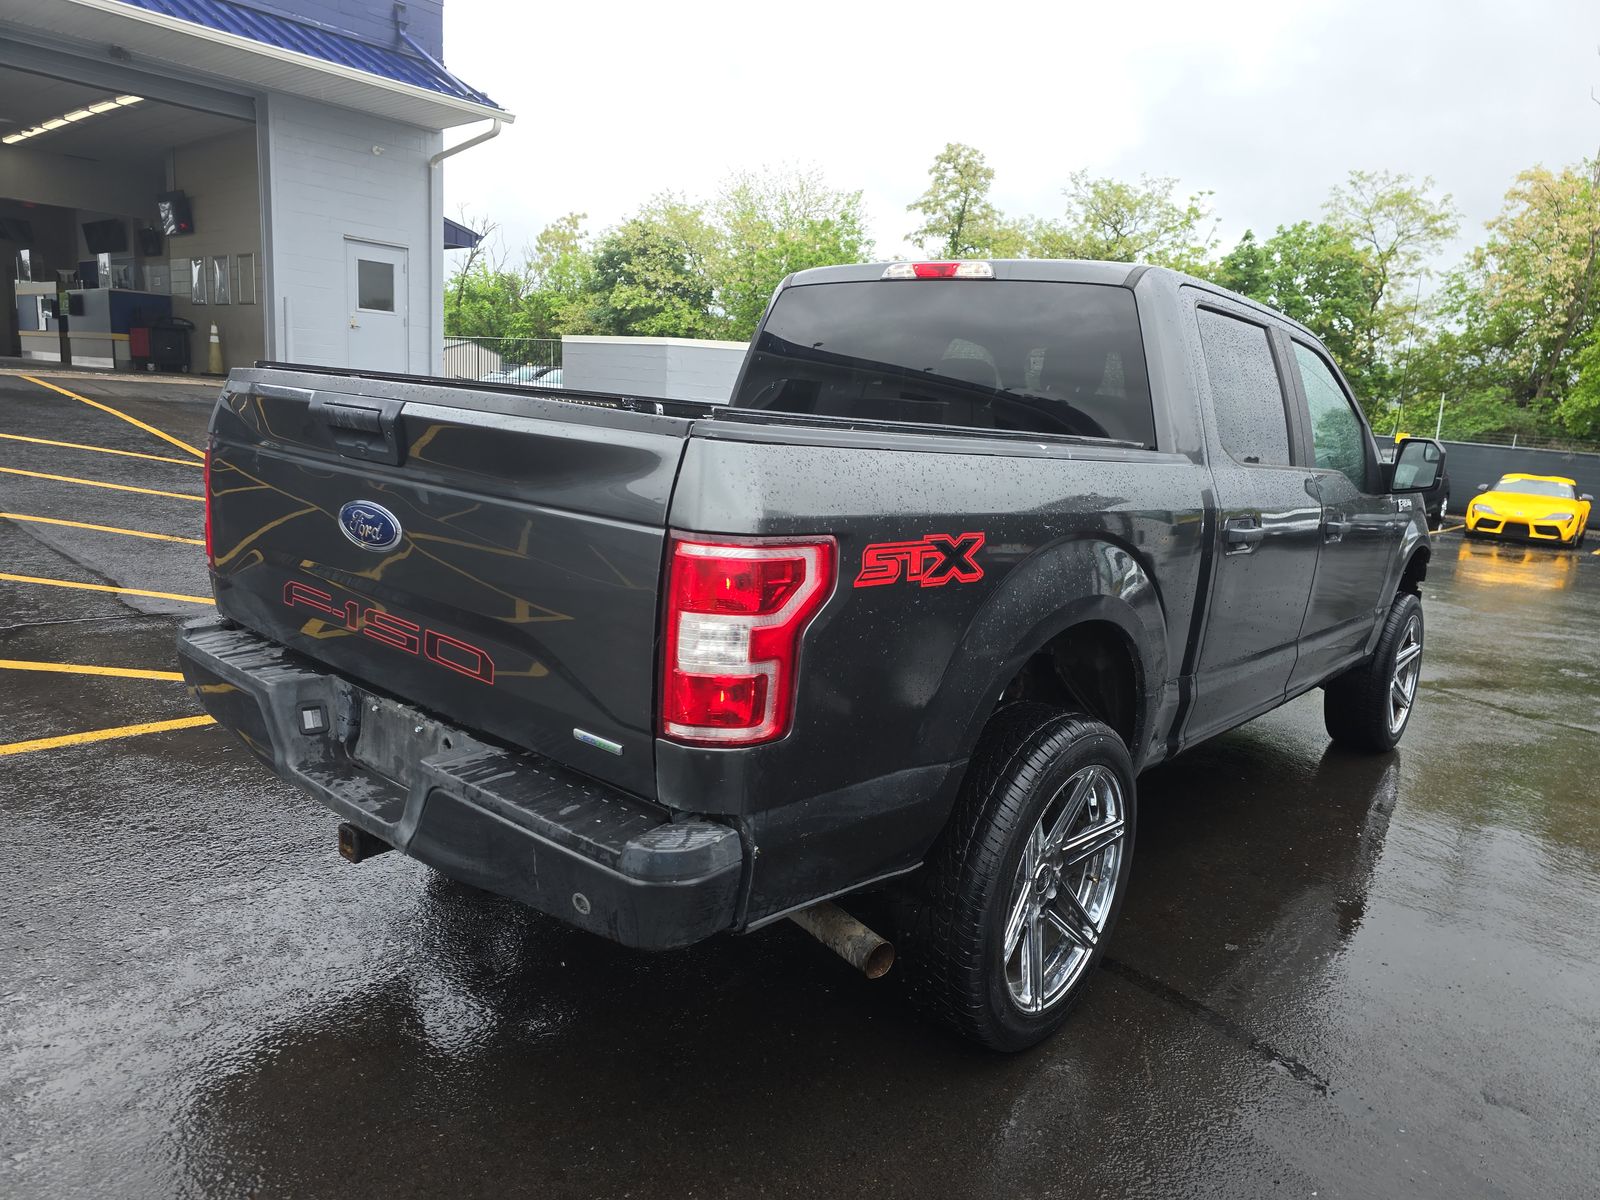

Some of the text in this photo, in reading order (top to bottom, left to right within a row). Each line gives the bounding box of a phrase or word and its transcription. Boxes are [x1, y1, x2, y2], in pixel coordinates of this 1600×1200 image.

[349, 509, 383, 541] Ford
[853, 531, 985, 588] STX
[284, 580, 495, 685] F-150
